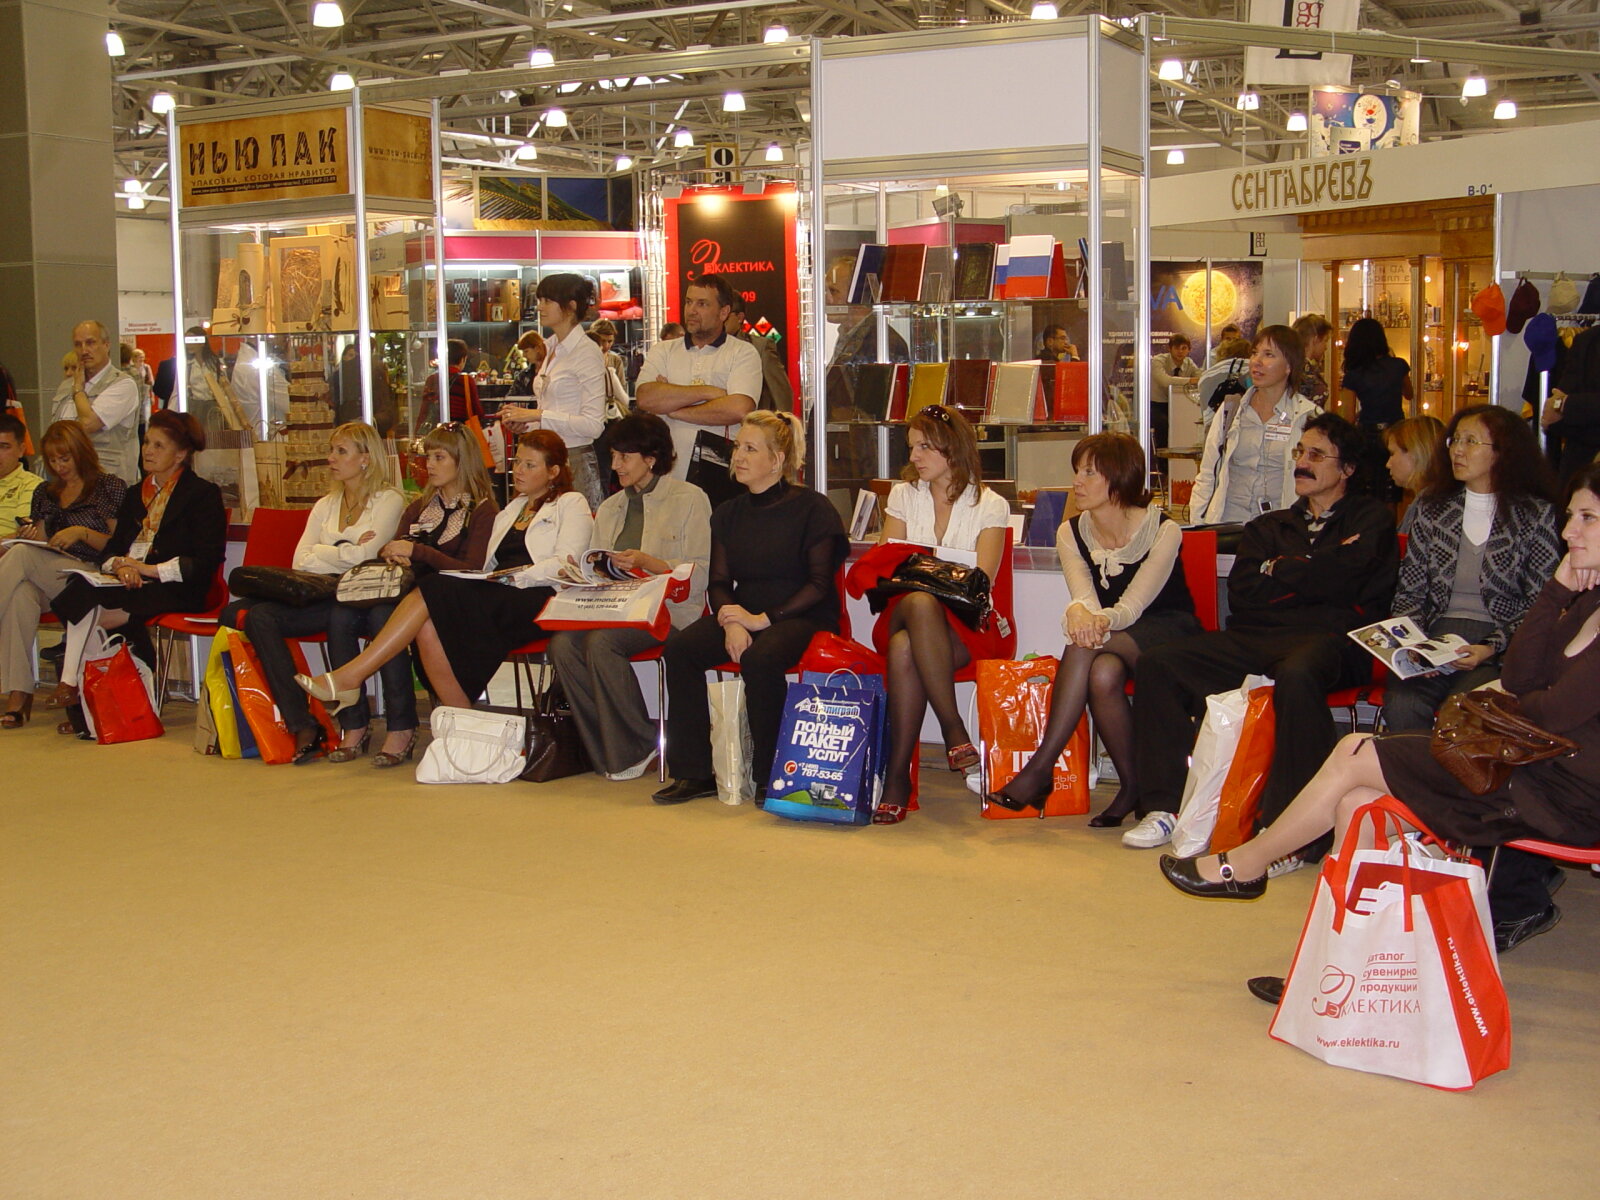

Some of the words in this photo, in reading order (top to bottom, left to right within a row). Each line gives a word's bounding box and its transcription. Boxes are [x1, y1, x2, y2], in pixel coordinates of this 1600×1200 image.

[189, 136, 260, 176] НЬЮ
[271, 127, 337, 167] ПАК
[191, 176, 241, 187] УПАКОВКА,
[244, 172, 285, 181] КОТОРАЯ
[288, 167, 336, 177] НРАВИТСЯ
[795, 720, 855, 738] ПОЛНЫЙ
[791, 731, 853, 751] ПАКЕТ
[807, 748, 850, 763] УСЛУГ
[801, 768, 843, 781] 787-53-65
[1367, 953, 1406, 963] аталог
[1360, 983, 1418, 994] продукции
[1447, 936, 1488, 1037] www.eklektika.ru
[1316, 1035, 1400, 1049] www.eklektika.ru
